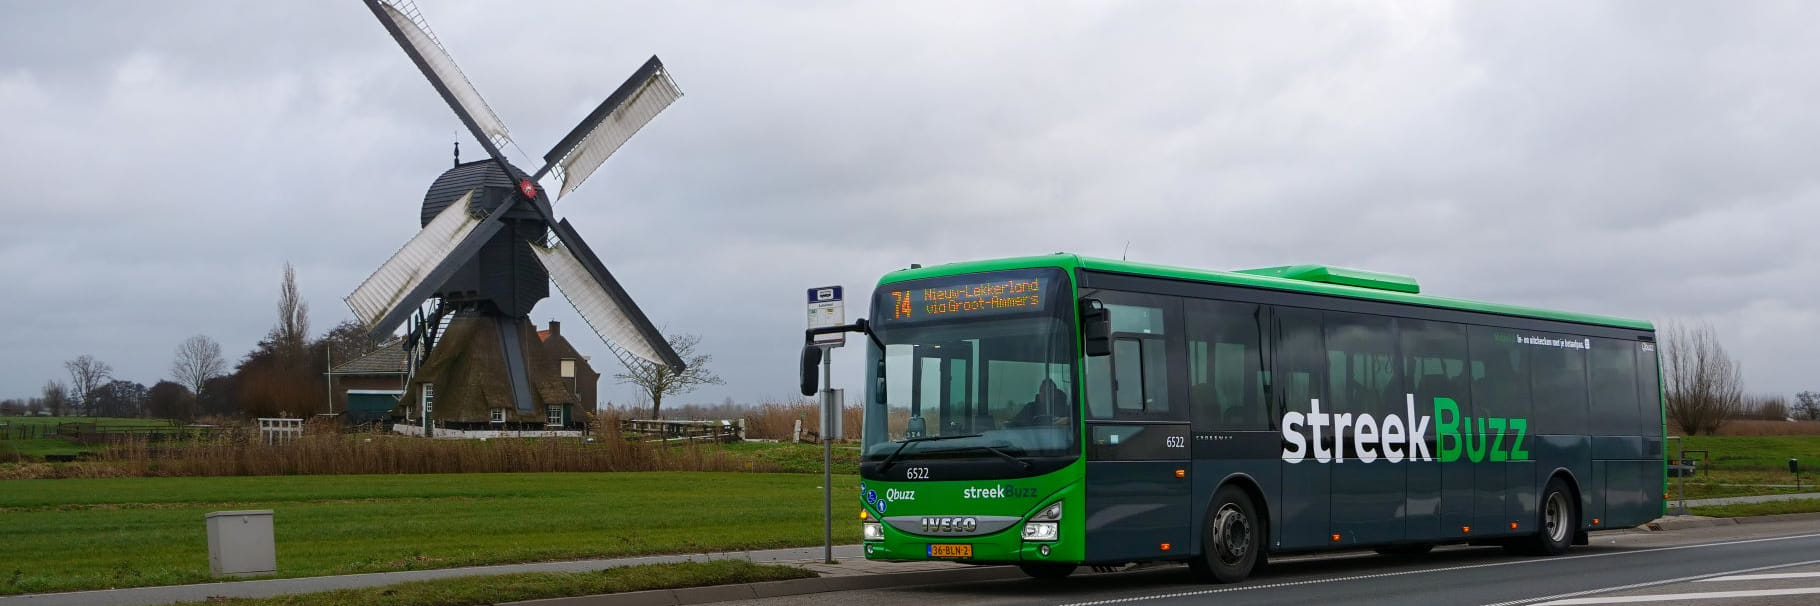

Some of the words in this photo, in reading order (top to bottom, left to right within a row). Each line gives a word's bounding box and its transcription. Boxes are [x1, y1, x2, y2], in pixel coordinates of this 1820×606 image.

[924, 277, 1040, 301] Nieuw-Lekkerland
[891, 290, 911, 319] 74
[926, 301, 946, 314] via
[949, 295, 1039, 313] Groot-Ammers
[1281, 393, 1529, 464] streekBuzz
[1166, 436, 1185, 448] 6522
[906, 467, 929, 480] 6522
[886, 488, 916, 502] Qbuzz
[963, 484, 1038, 499] streekBuzz
[921, 516, 977, 533] IVECO
[933, 545, 969, 556] 36-BLN-2
